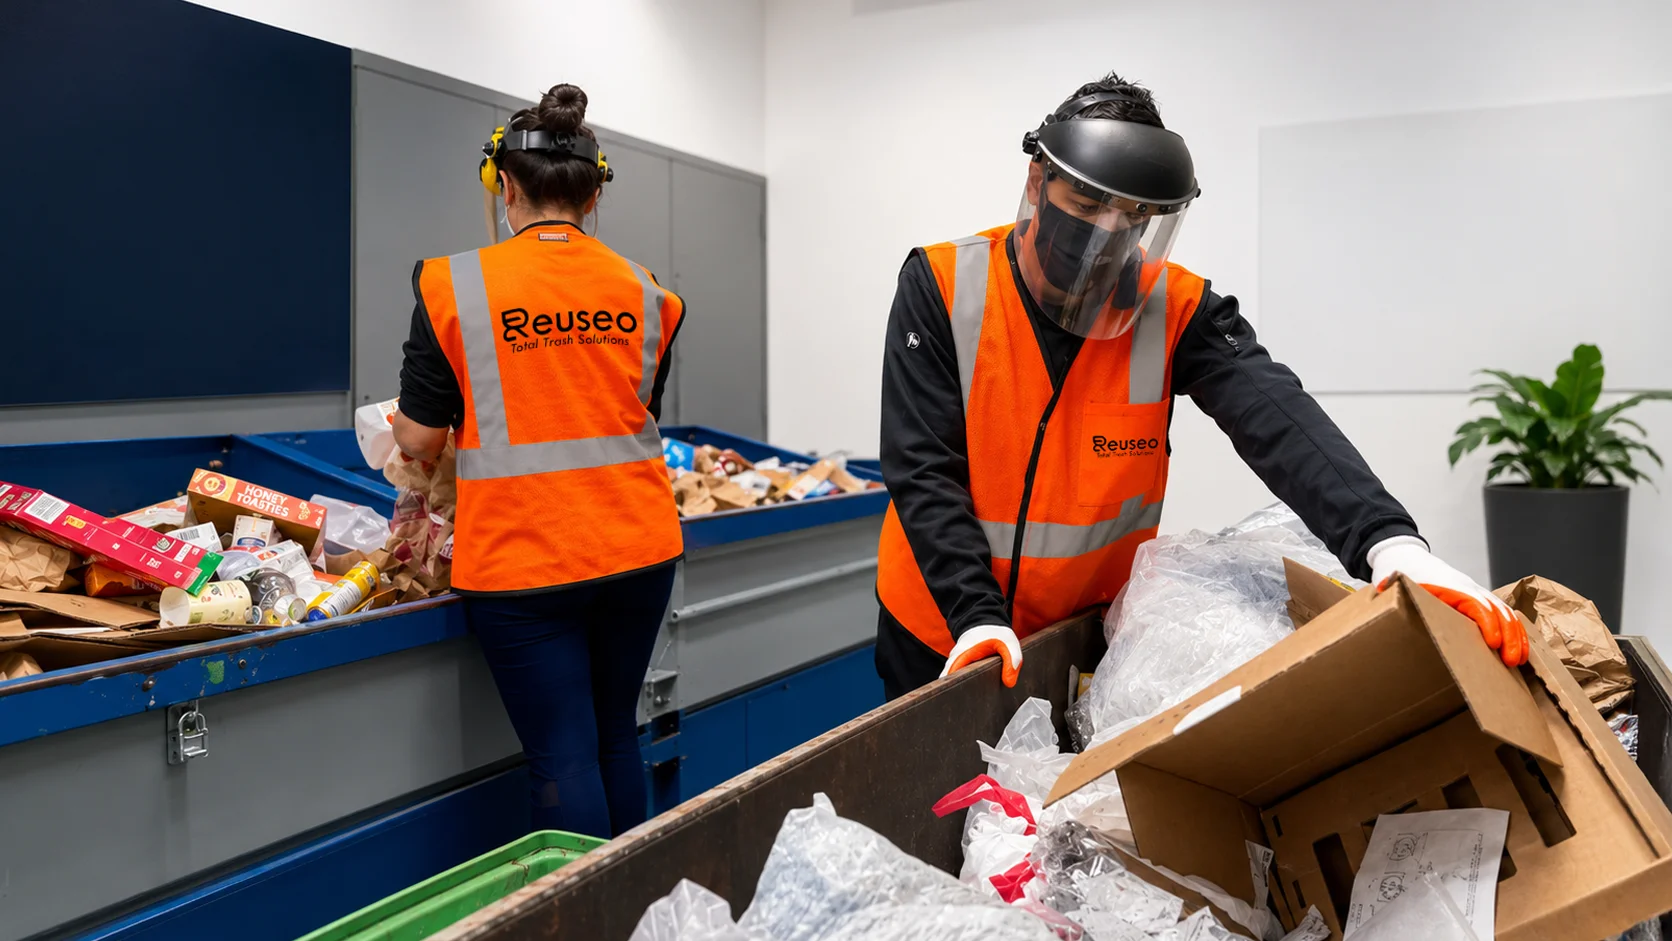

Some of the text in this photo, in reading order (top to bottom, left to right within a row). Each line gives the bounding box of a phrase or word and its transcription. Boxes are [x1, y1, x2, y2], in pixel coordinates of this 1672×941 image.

[501, 308, 637, 342] Reuseo
[511, 334, 629, 354] Total Trash Solutions
[1093, 436, 1158, 452] Reuseo
[245, 485, 288, 503] HONEY
[237, 492, 289, 517] TOASTIES
